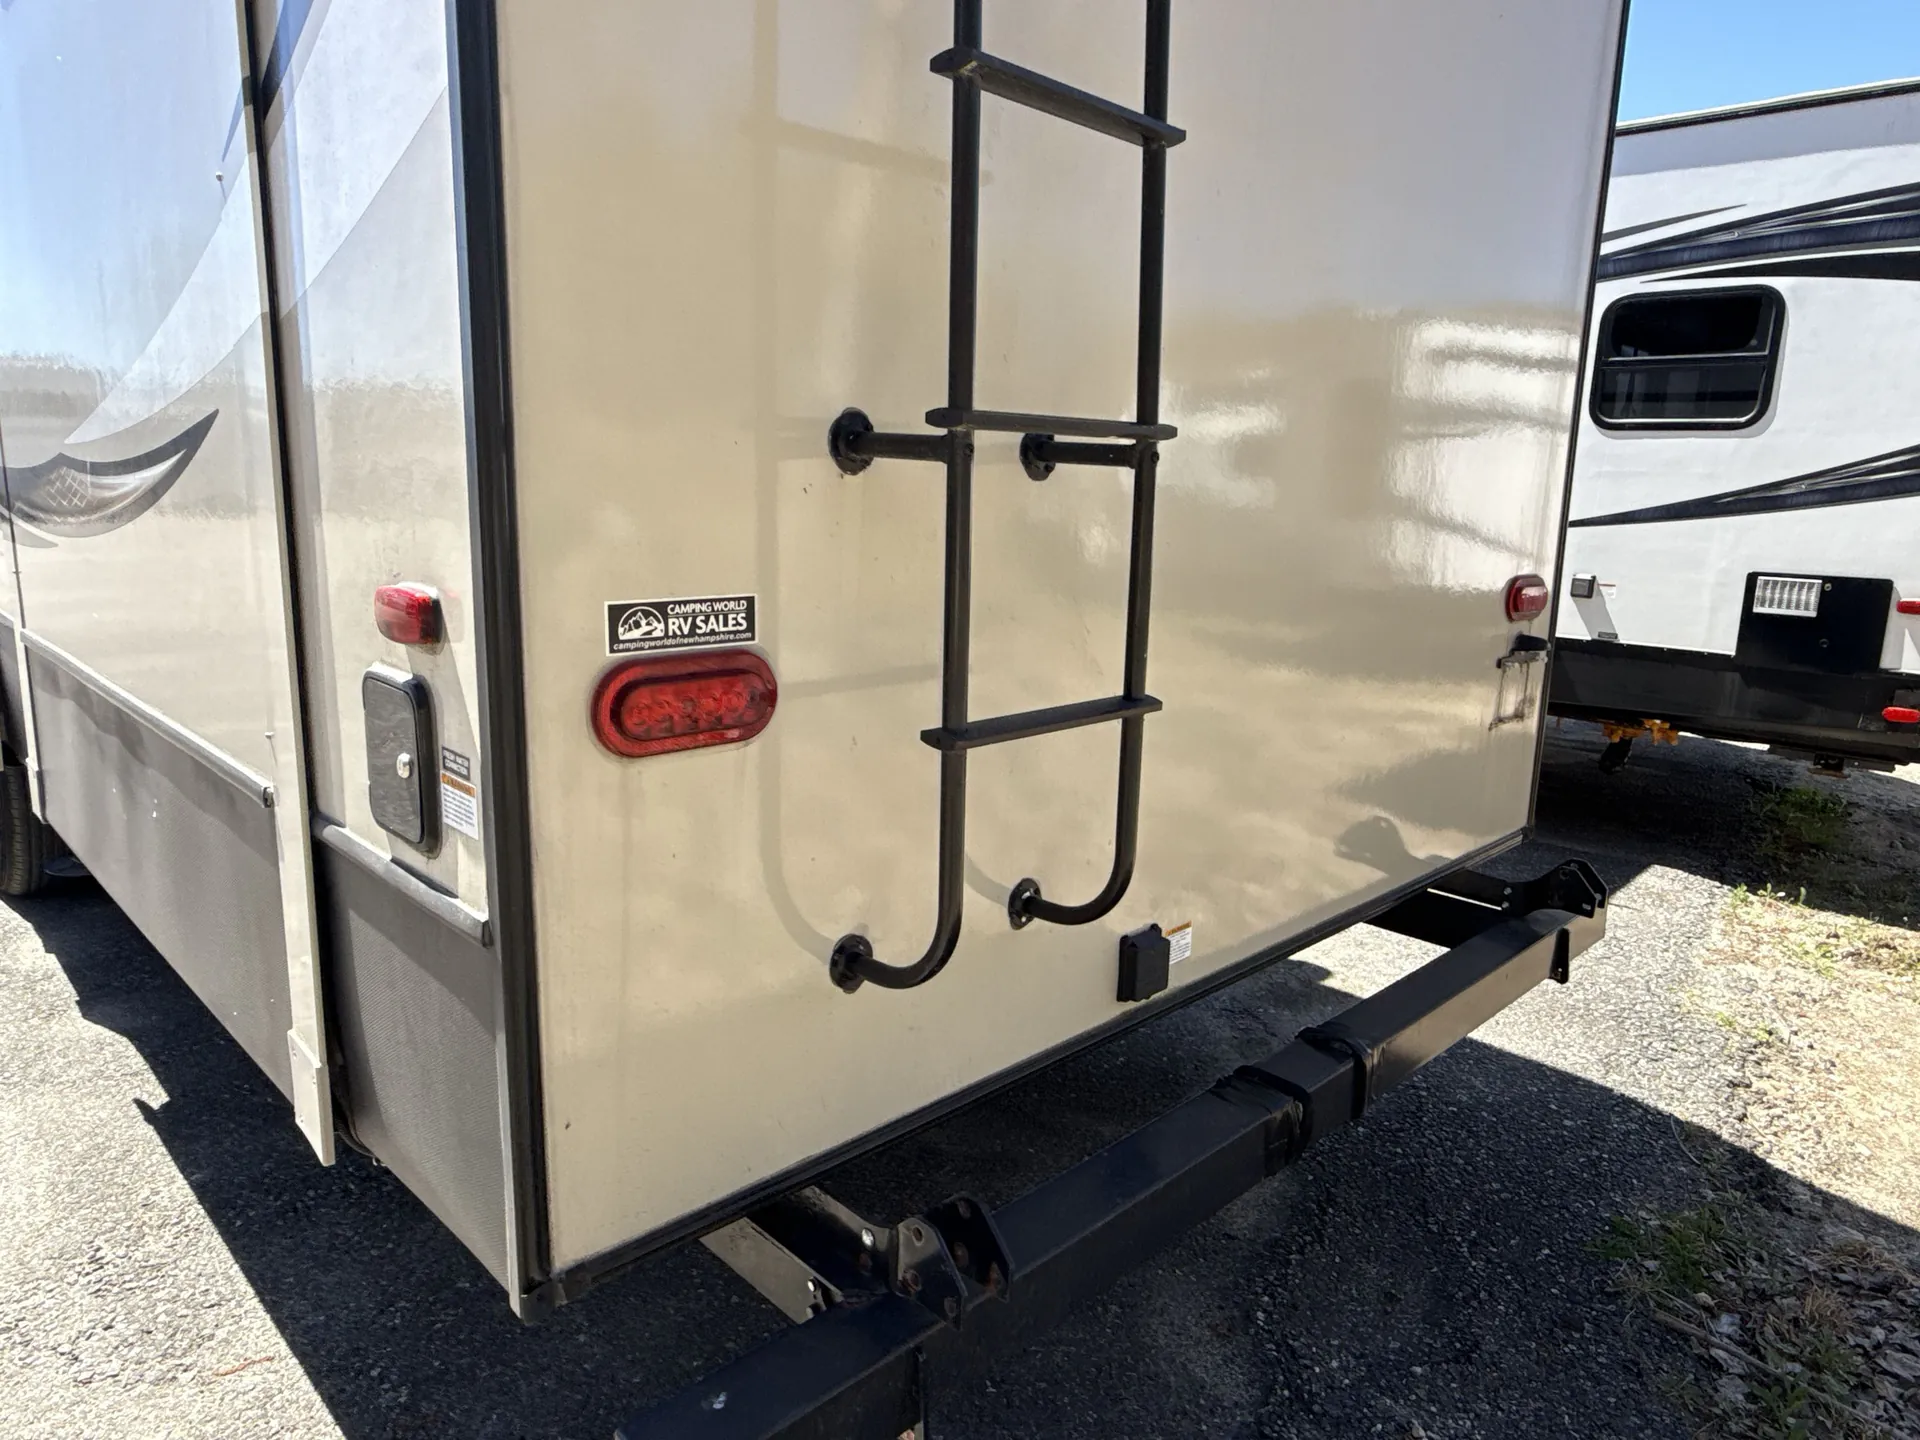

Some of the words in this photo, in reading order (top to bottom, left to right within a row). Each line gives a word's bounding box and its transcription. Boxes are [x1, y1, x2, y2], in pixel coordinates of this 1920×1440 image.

[667, 602, 712, 615] CAMPING
[713, 600, 747, 611] WORLD
[668, 617, 692, 636] RV
[695, 613, 747, 634] SALES
[613, 632, 752, 650] campingworldofnewhampshire.com
